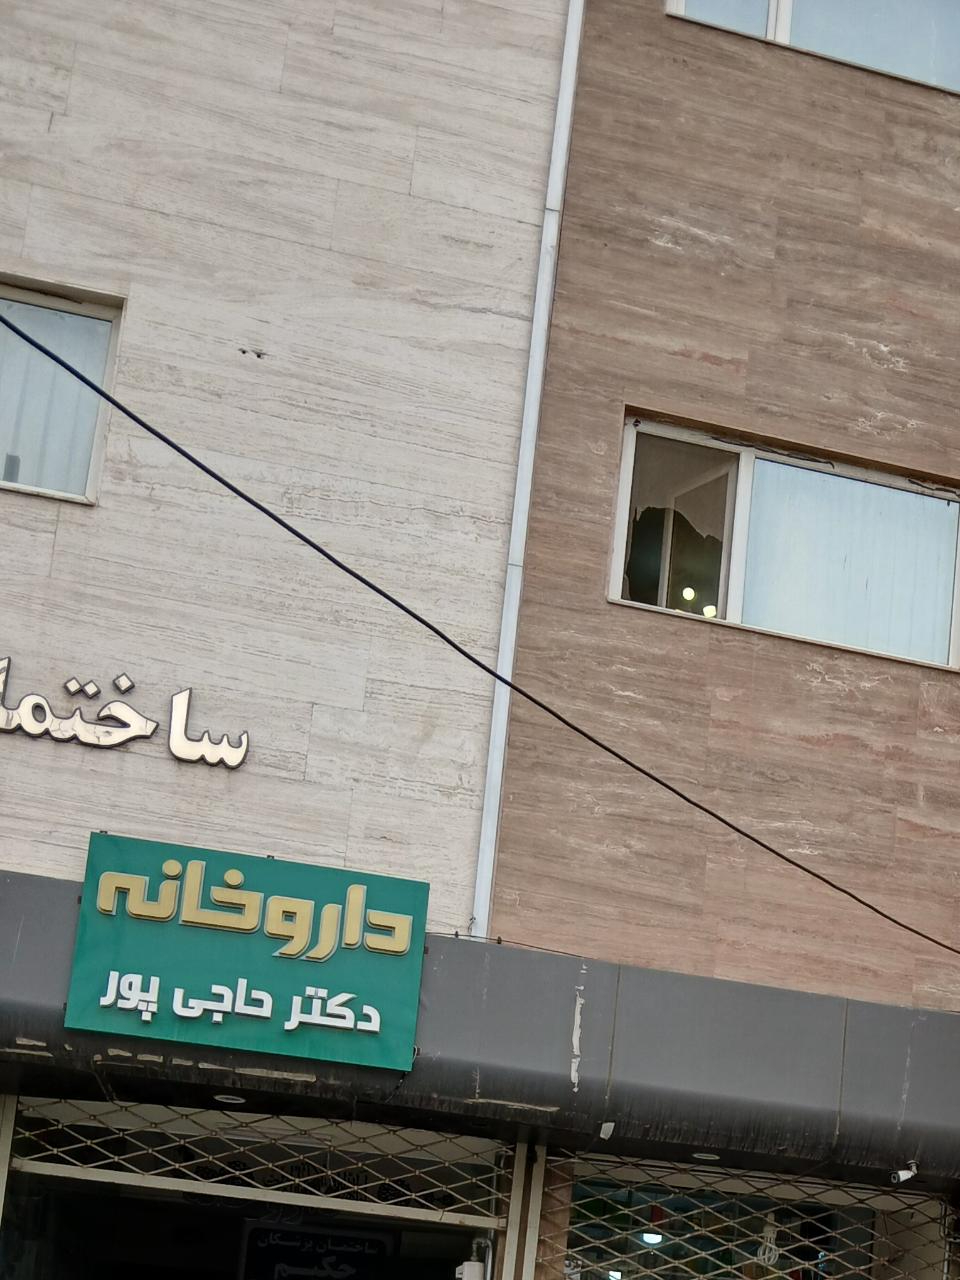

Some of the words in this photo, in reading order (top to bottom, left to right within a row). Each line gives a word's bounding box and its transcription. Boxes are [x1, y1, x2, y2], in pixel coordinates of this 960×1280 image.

[96, 858, 413, 963] داروخانه
[99, 969, 160, 1023] پور
[172, 978, 274, 1024] حاجی
[283, 987, 383, 1033] دکتر
